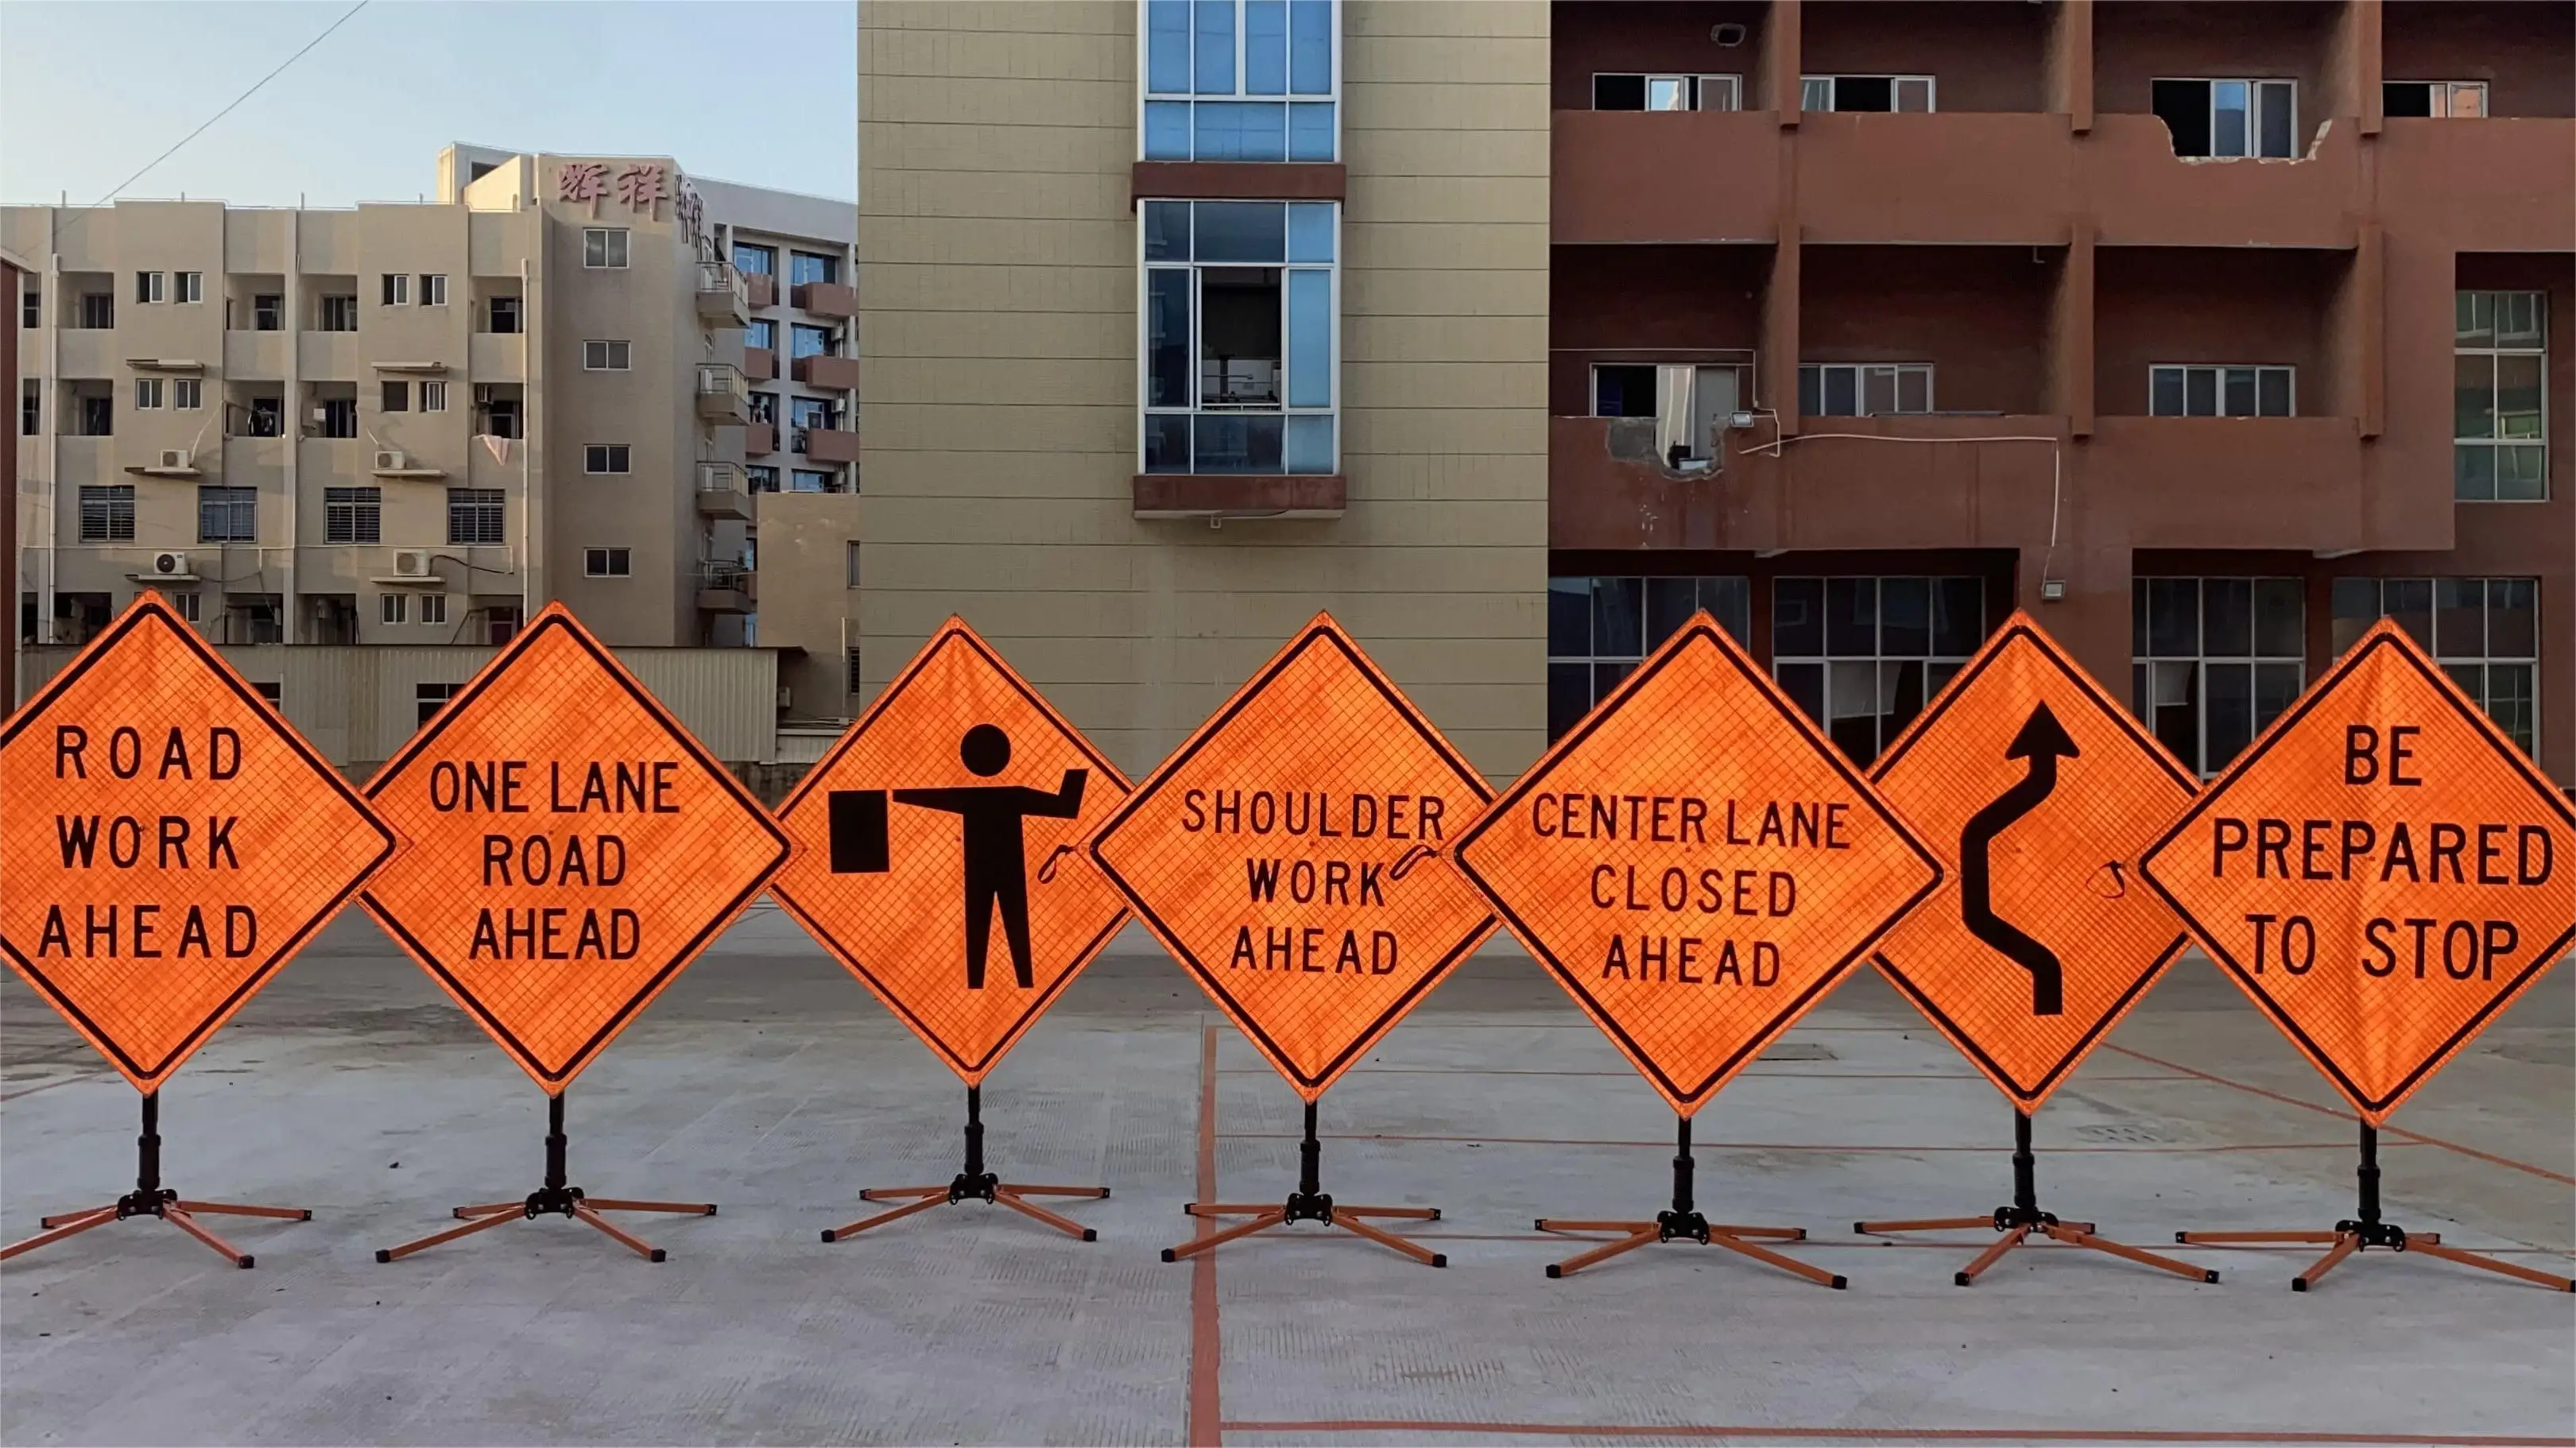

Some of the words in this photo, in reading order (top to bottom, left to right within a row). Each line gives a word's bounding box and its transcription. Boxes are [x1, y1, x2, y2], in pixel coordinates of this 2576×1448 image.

[56, 725, 242, 780] ROAD
[2345, 724, 2422, 786] BE
[430, 761, 529, 813] ONE
[551, 761, 680, 813] LANE
[1183, 789, 1444, 840] SHOULDER
[1532, 793, 1706, 842] CENTER
[1727, 802, 1849, 849] LANE
[56, 815, 239, 869] WORK
[483, 834, 626, 886] ROAD
[2214, 818, 2553, 886] PREPARED
[1246, 858, 1384, 907] WORK
[1591, 864, 1795, 917] CLOSED
[37, 904, 258, 958] AHEAD
[469, 908, 640, 960] AHEAD
[1230, 926, 1397, 975] AHEAD
[2246, 914, 2316, 976] TO
[2361, 917, 2520, 981] STOP
[1603, 935, 1780, 987] AHEAD
